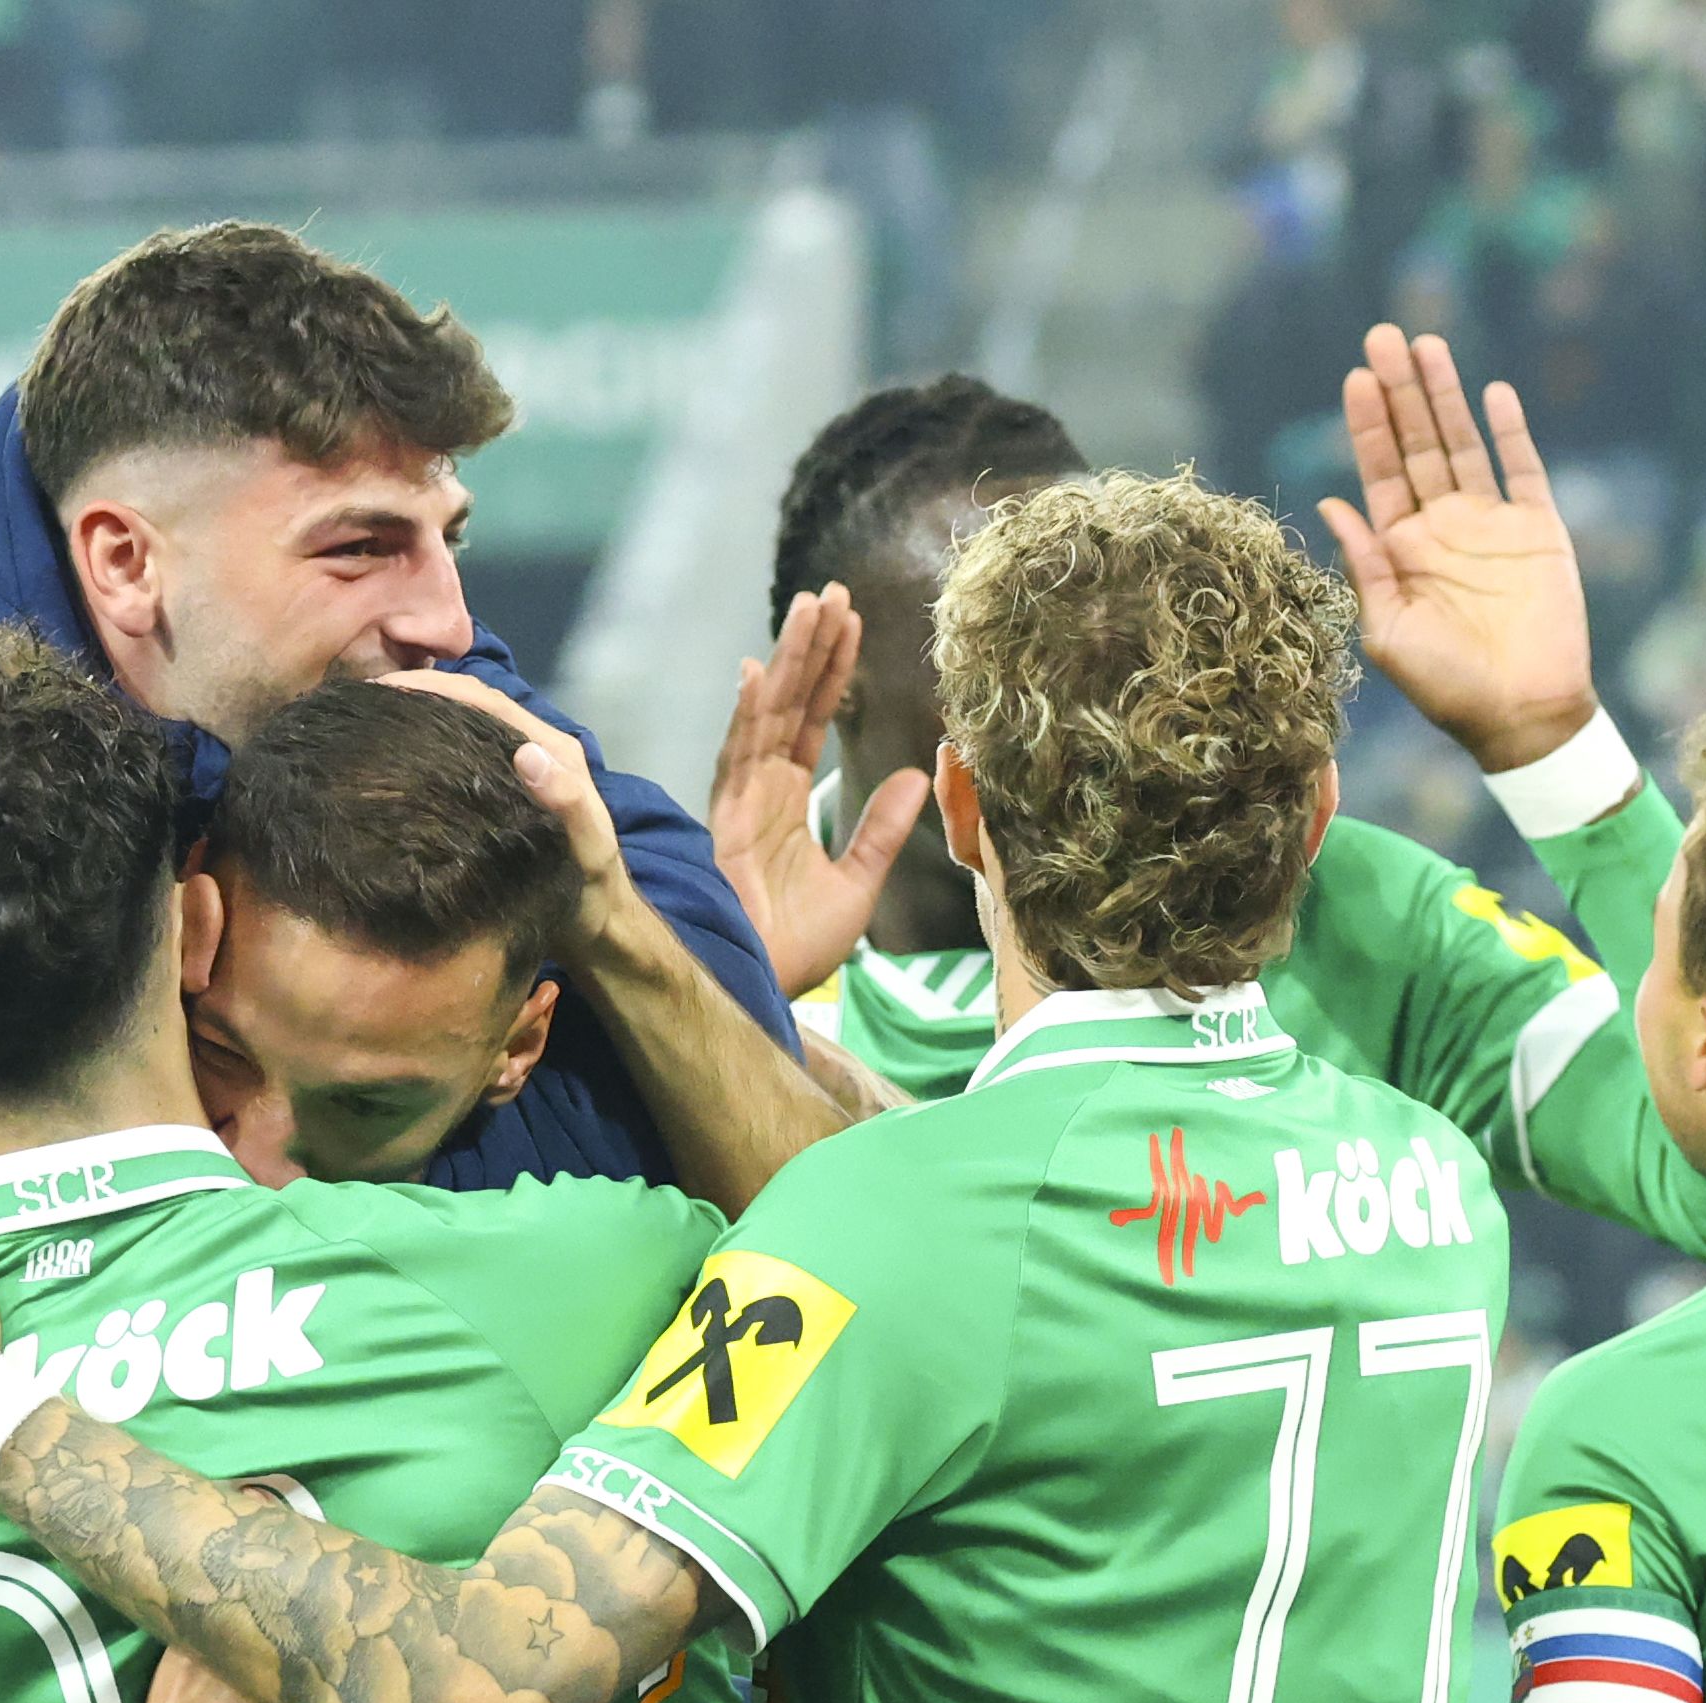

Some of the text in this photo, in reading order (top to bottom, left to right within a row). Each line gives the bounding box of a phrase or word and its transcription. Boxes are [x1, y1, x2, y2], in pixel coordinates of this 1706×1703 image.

[1192, 1006, 1261, 1048] SCR
[13, 1161, 120, 1216] SCR
[1273, 1137, 1474, 1265] köck
[560, 1452, 672, 1522] SCR
